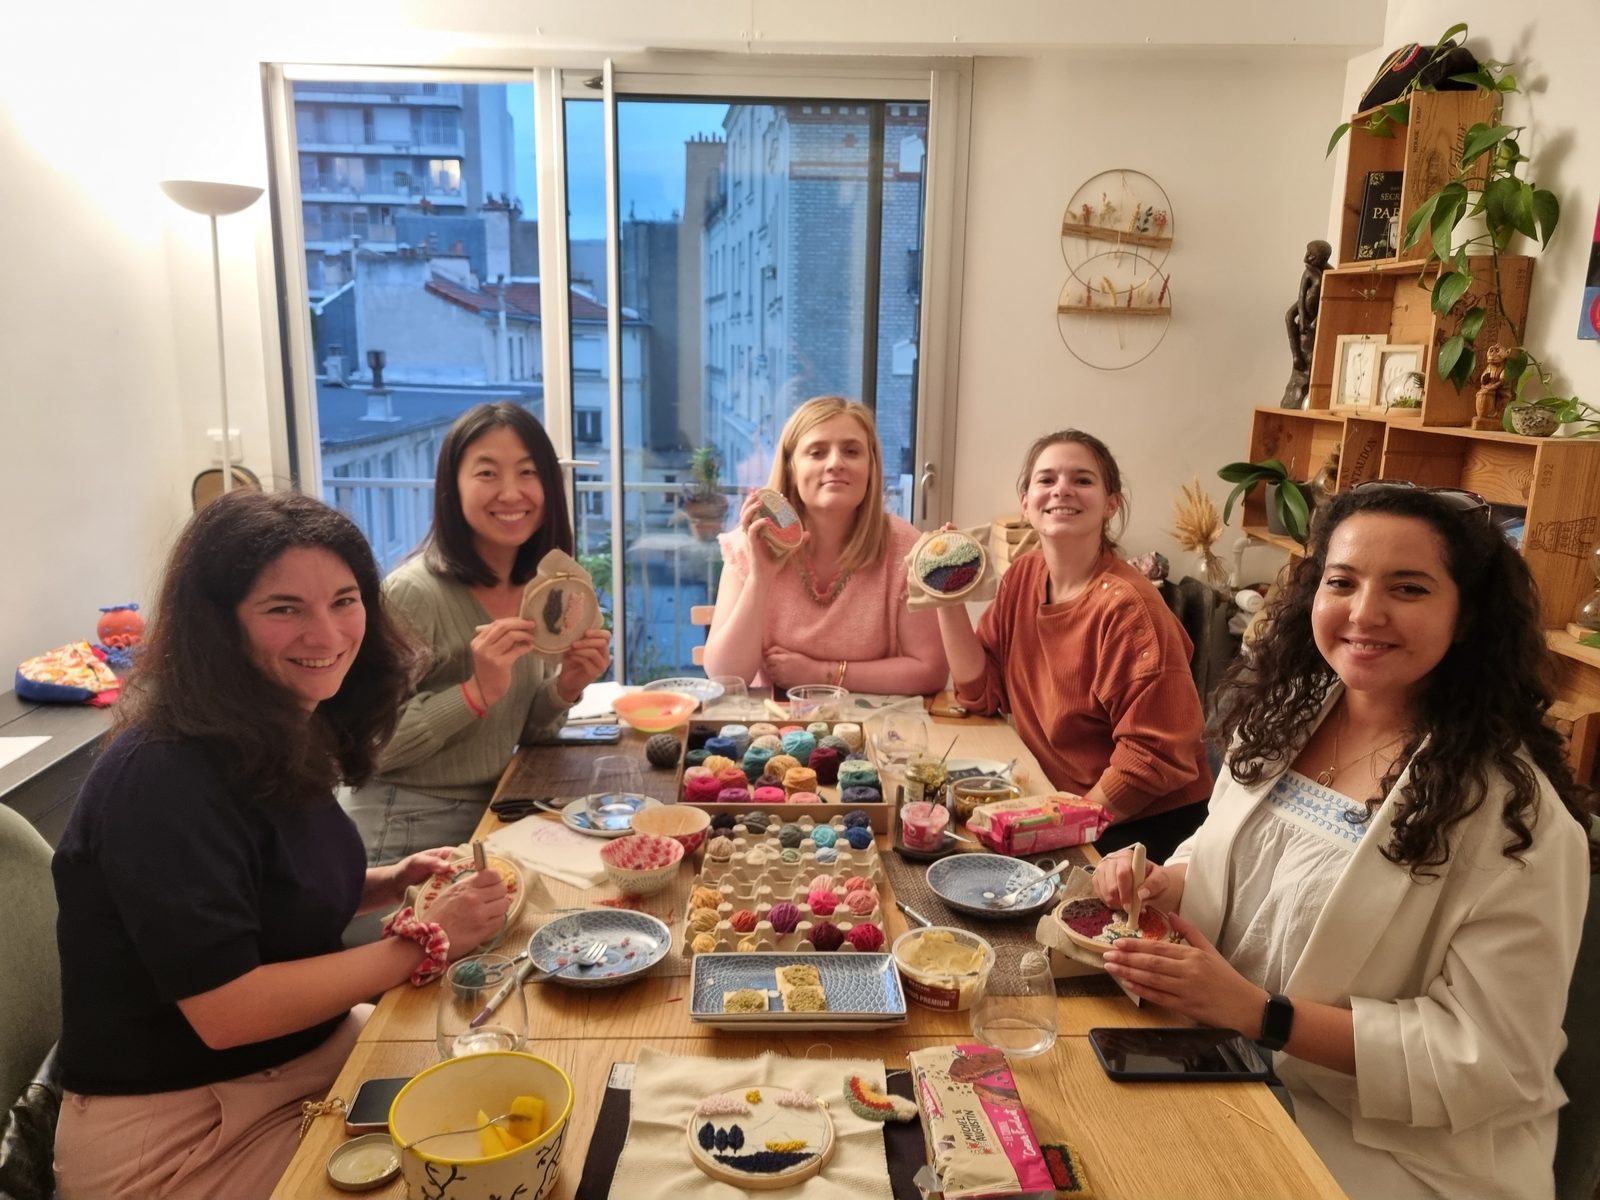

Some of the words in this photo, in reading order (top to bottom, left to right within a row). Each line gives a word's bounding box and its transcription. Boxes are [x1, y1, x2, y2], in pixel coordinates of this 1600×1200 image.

[920, 995, 950, 1007] PREMIUM
[956, 1117, 976, 1142] MICHEL
[963, 1109, 987, 1142] AUGUSTIN
